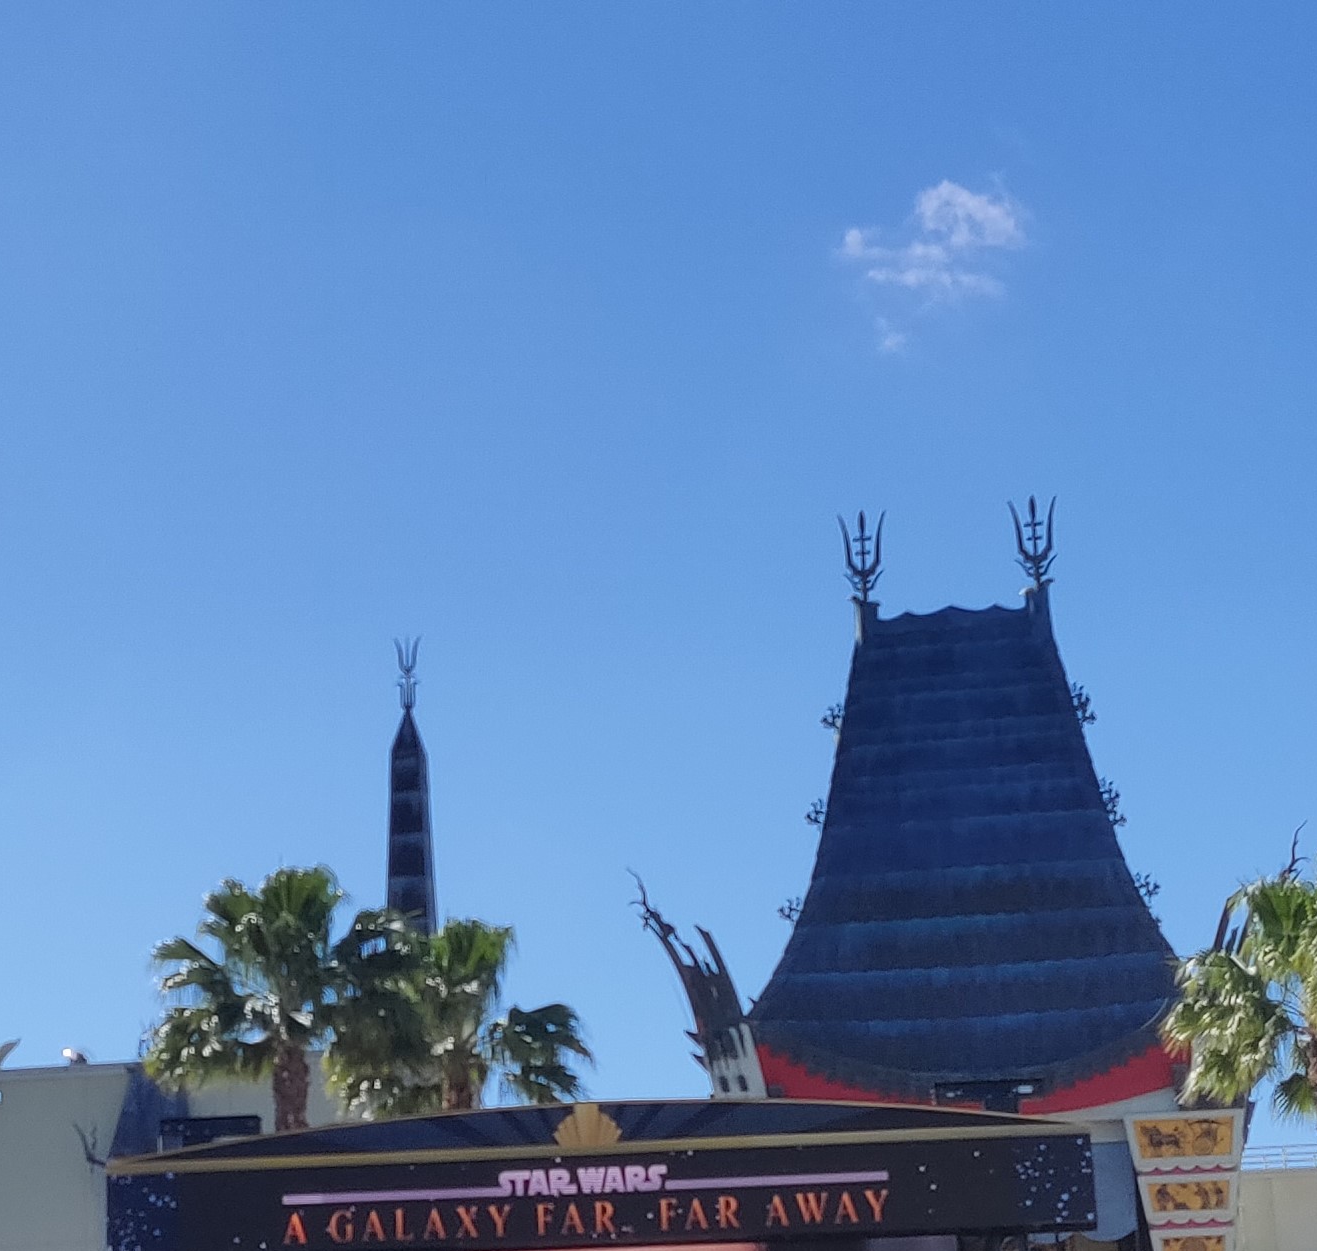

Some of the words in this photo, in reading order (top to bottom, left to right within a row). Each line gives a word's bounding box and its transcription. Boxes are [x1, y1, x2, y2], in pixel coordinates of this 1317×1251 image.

[498, 1168, 577, 1197] STAR
[577, 1164, 668, 1194] WARS
[284, 1211, 308, 1245] A
[328, 1204, 512, 1243] GALAXY
[658, 1195, 740, 1232] FAR
[767, 1189, 889, 1228] AWAY
